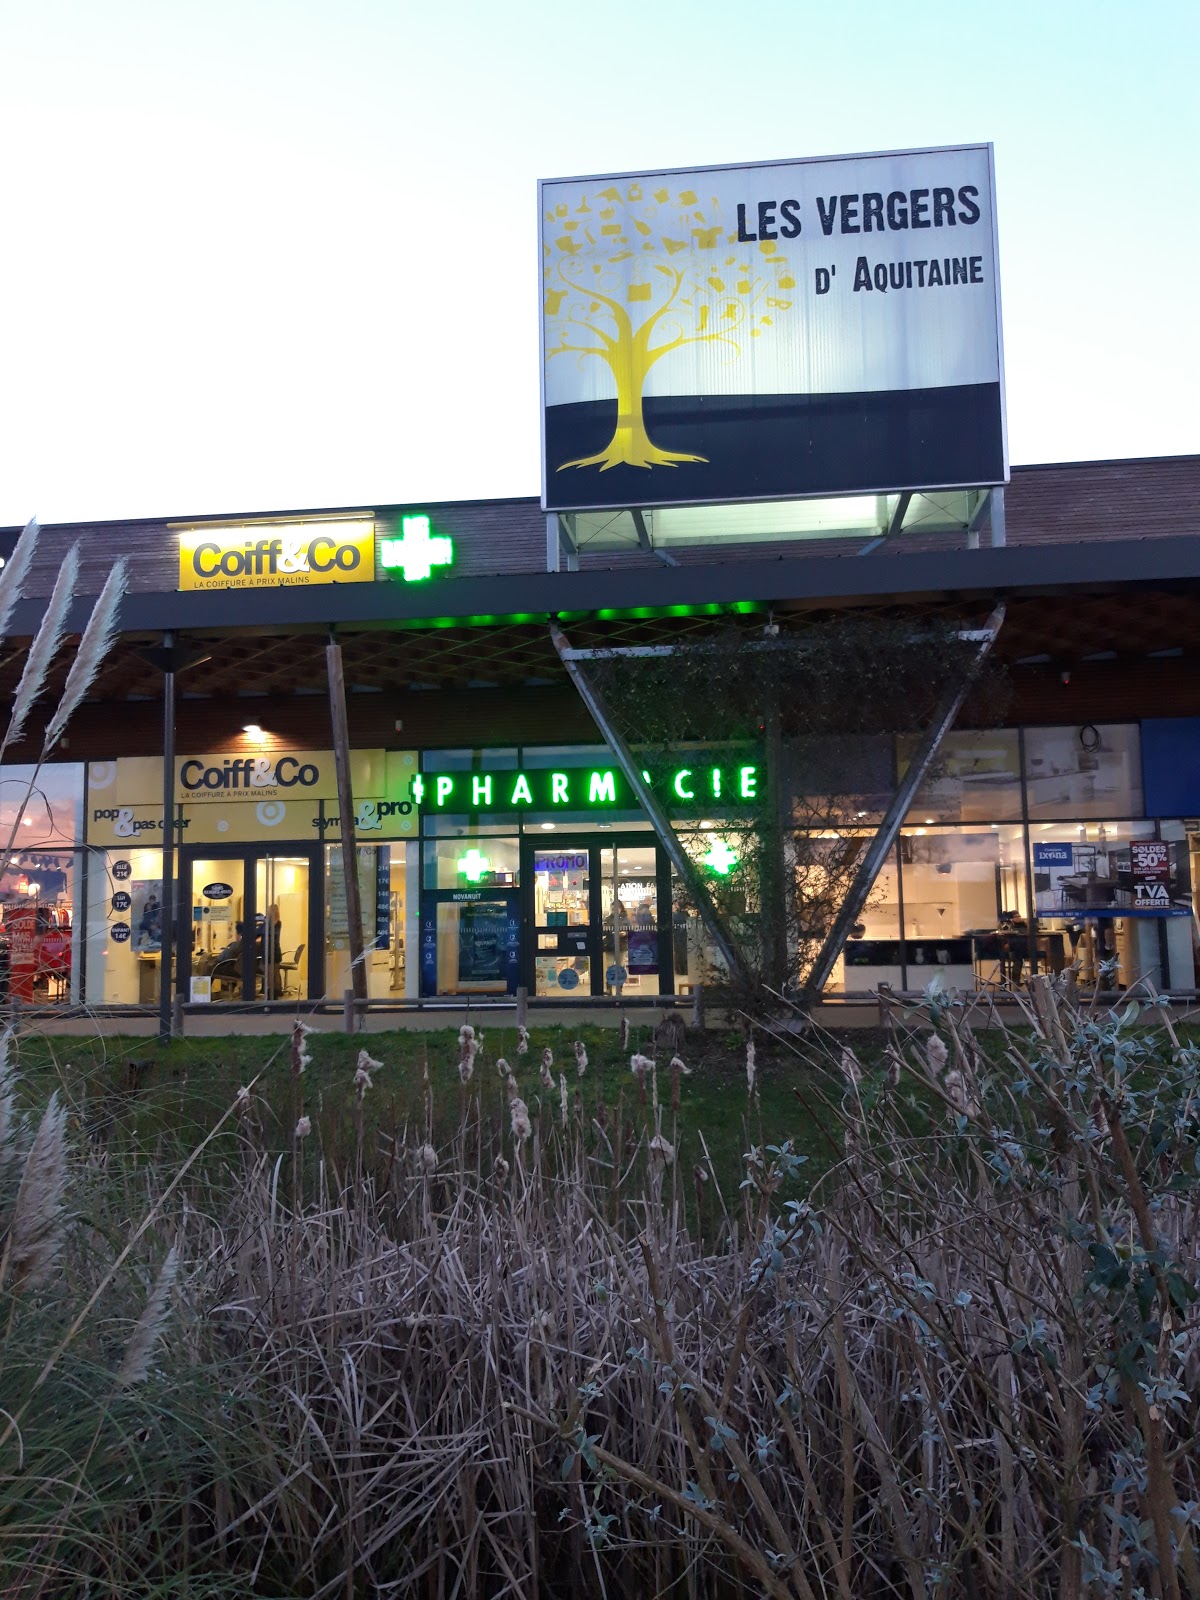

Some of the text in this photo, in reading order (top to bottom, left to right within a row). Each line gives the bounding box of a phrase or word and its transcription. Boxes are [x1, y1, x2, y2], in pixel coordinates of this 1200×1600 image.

[737, 185, 981, 242] LES VERGERS
[853, 256, 984, 293] AQUITAINE
[193, 536, 361, 578] Coiff&Co
[194, 581, 205, 589] LA
[206, 579, 246, 588] COIFFURE
[256, 578, 276, 586] PRIX
[277, 576, 310, 585] MALINS
[180, 756, 320, 790] Coiff&Co
[435, 766, 757, 807] PHARMCIE
[192, 791, 225, 799] COIFFURE
[250, 789, 278, 797] MALINS
[158, 818, 191, 829] cer
[1132, 845, 1167, 854] SOLDES
[535, 855, 585, 869] PROMO
[1133, 853, 1168, 867] -50%
[1133, 885, 1170, 899] TVA
[1134, 898, 1170, 906] OFFERTE
